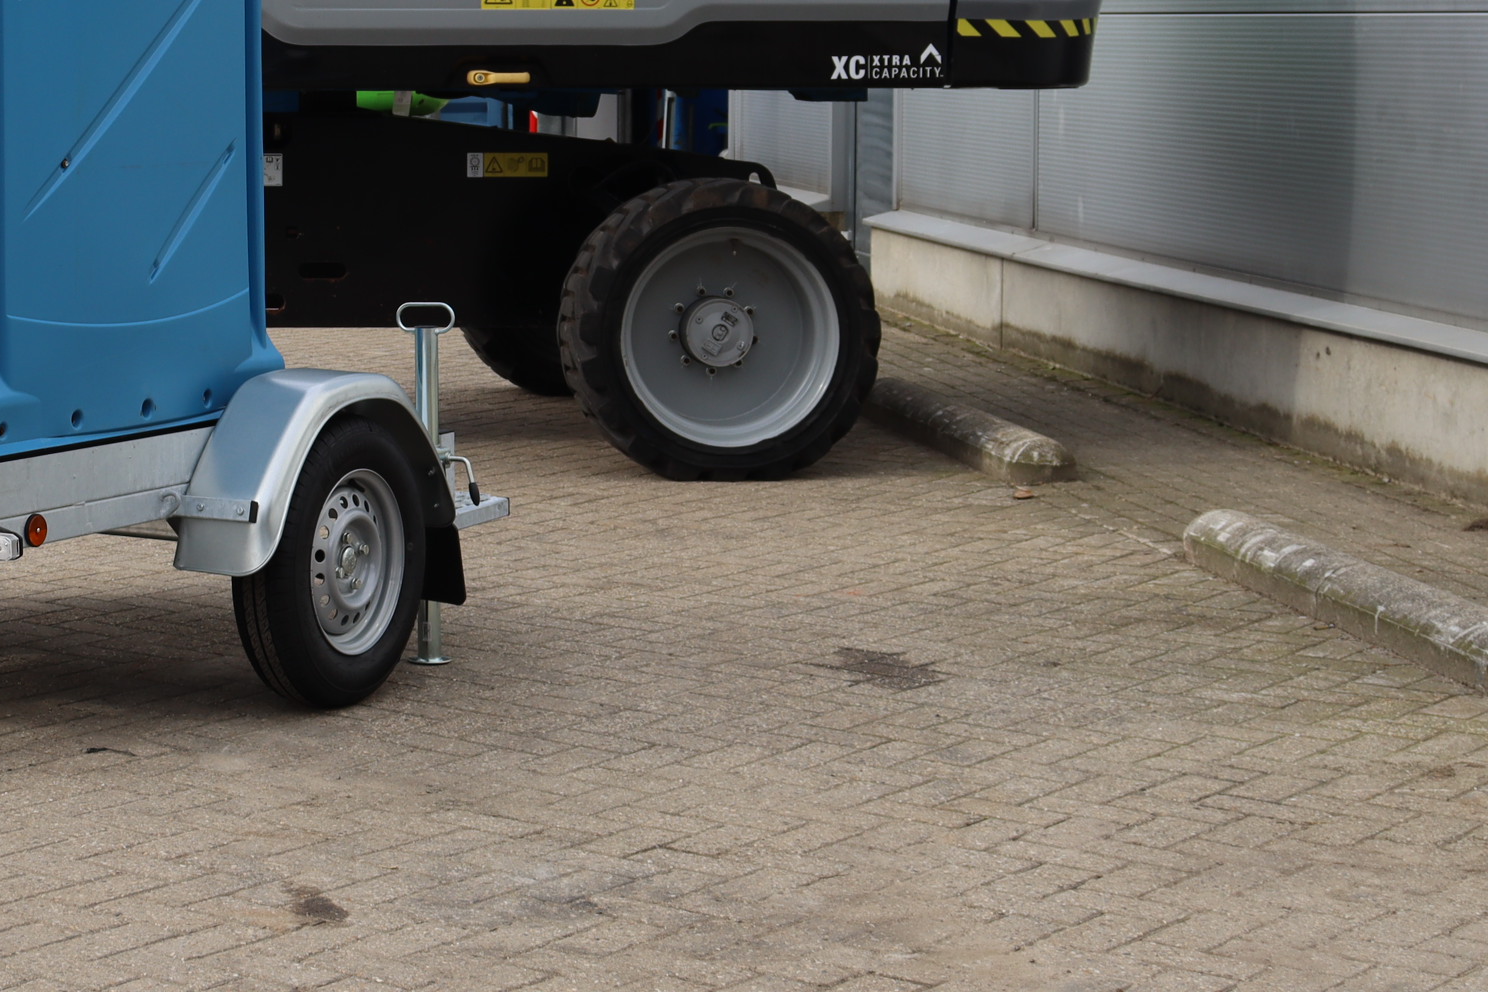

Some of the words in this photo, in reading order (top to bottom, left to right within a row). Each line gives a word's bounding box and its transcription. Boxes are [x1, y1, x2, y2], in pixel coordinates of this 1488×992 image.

[872, 54, 911, 66] XTRA
[831, 55, 866, 80] XC
[872, 67, 942, 79] CAPACITY
